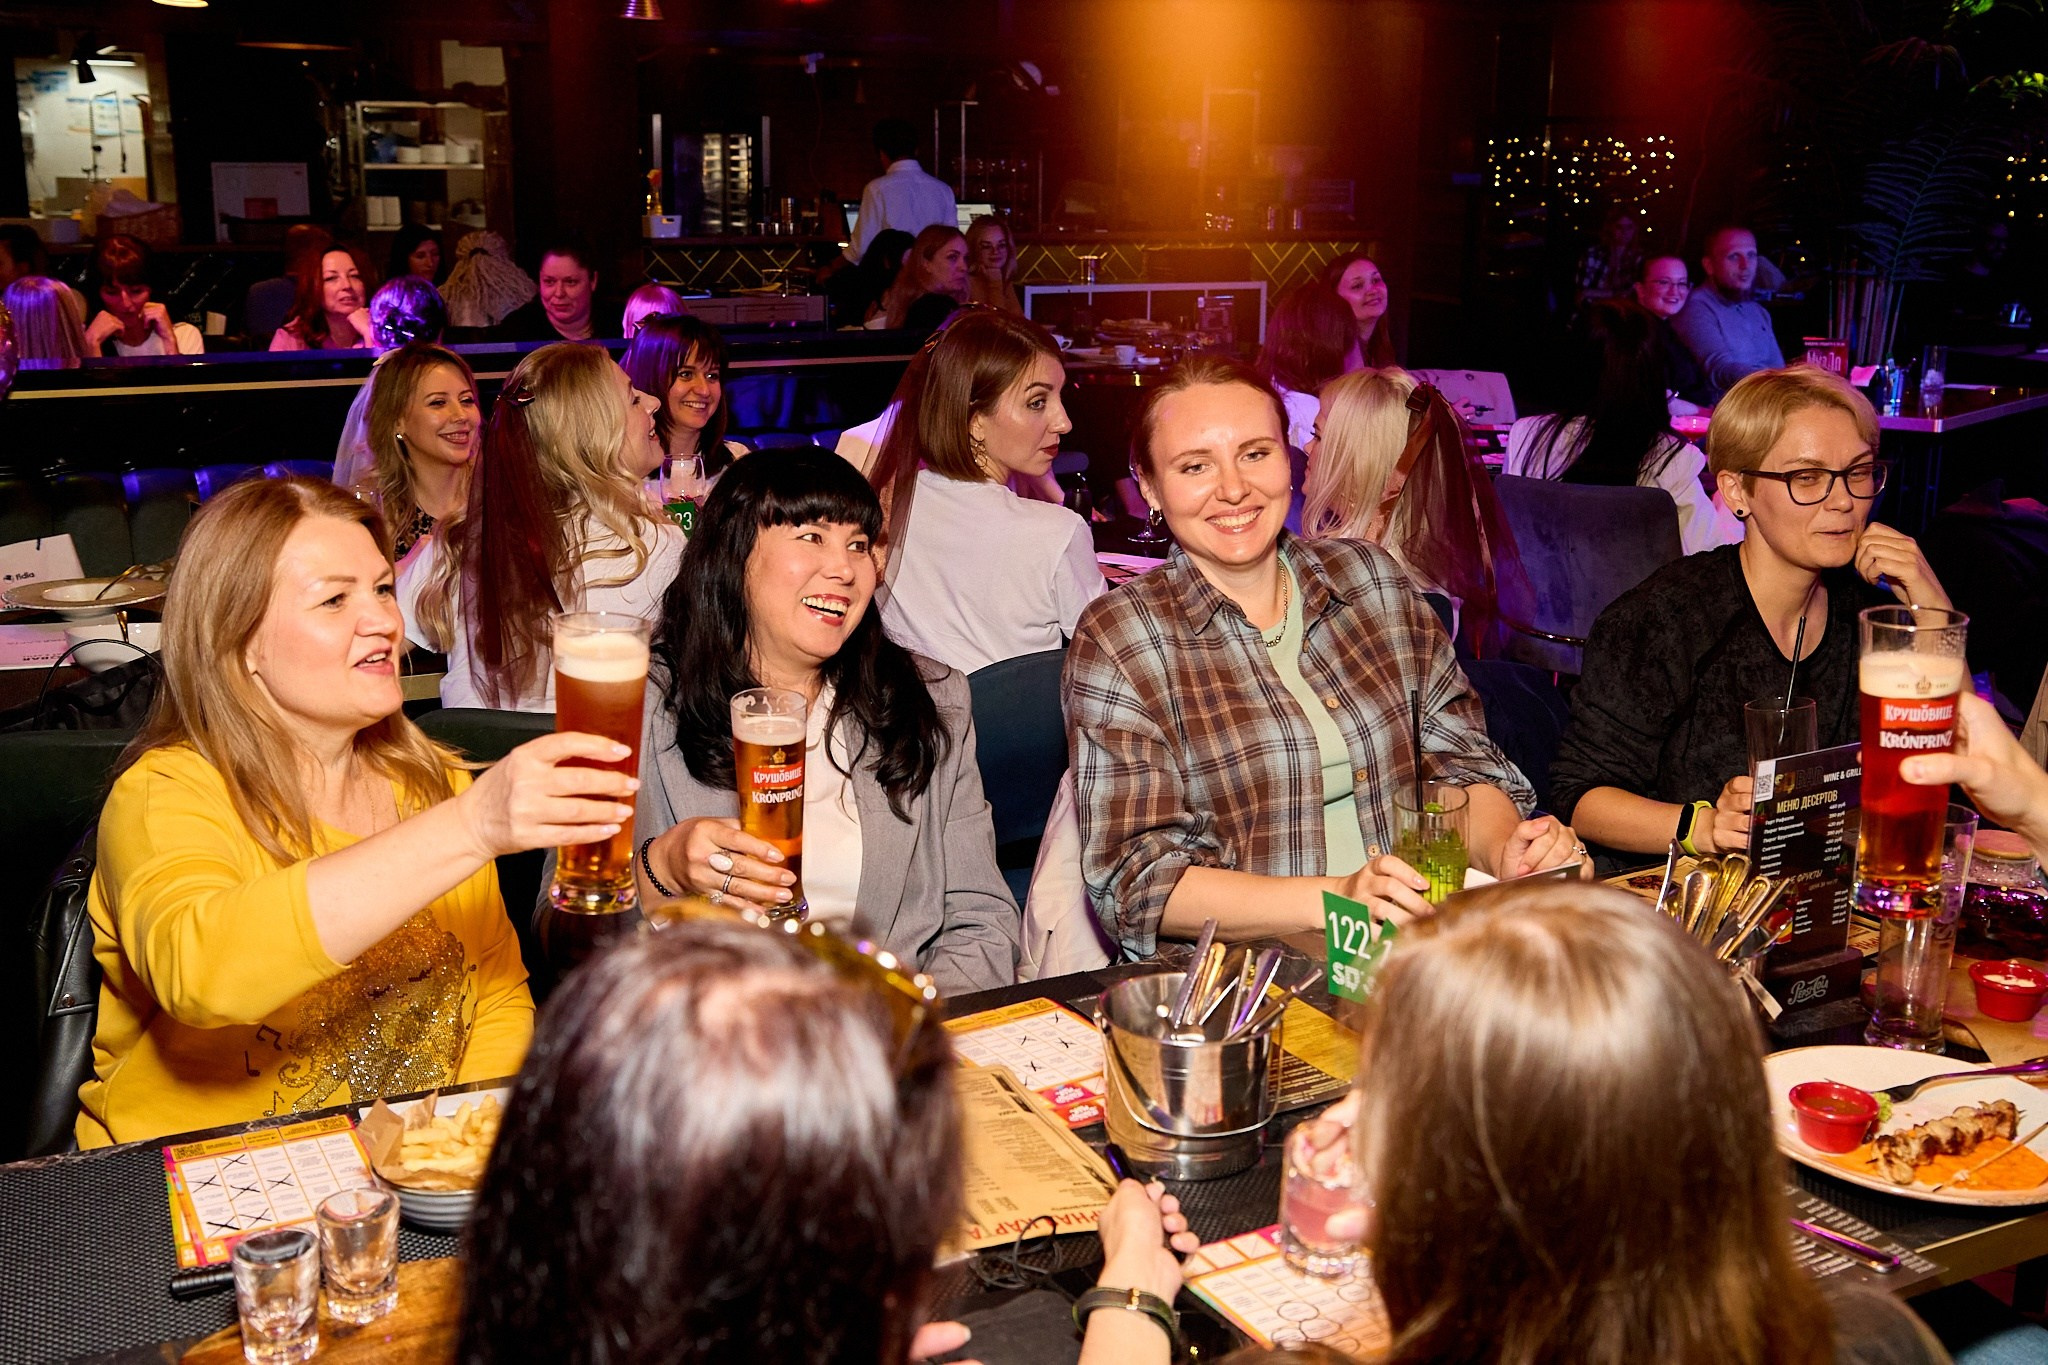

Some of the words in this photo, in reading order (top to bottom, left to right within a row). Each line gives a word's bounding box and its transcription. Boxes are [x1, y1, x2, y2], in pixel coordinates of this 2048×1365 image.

[667, 511, 692, 530] 23
[1823, 771, 1840, 783] WINE
[1846, 767, 1862, 778] GRILL
[1776, 798, 1800, 814] МЕНЮ
[1801, 790, 1838, 810] ДЕСЕРТОВ
[1328, 911, 1371, 960] 122
